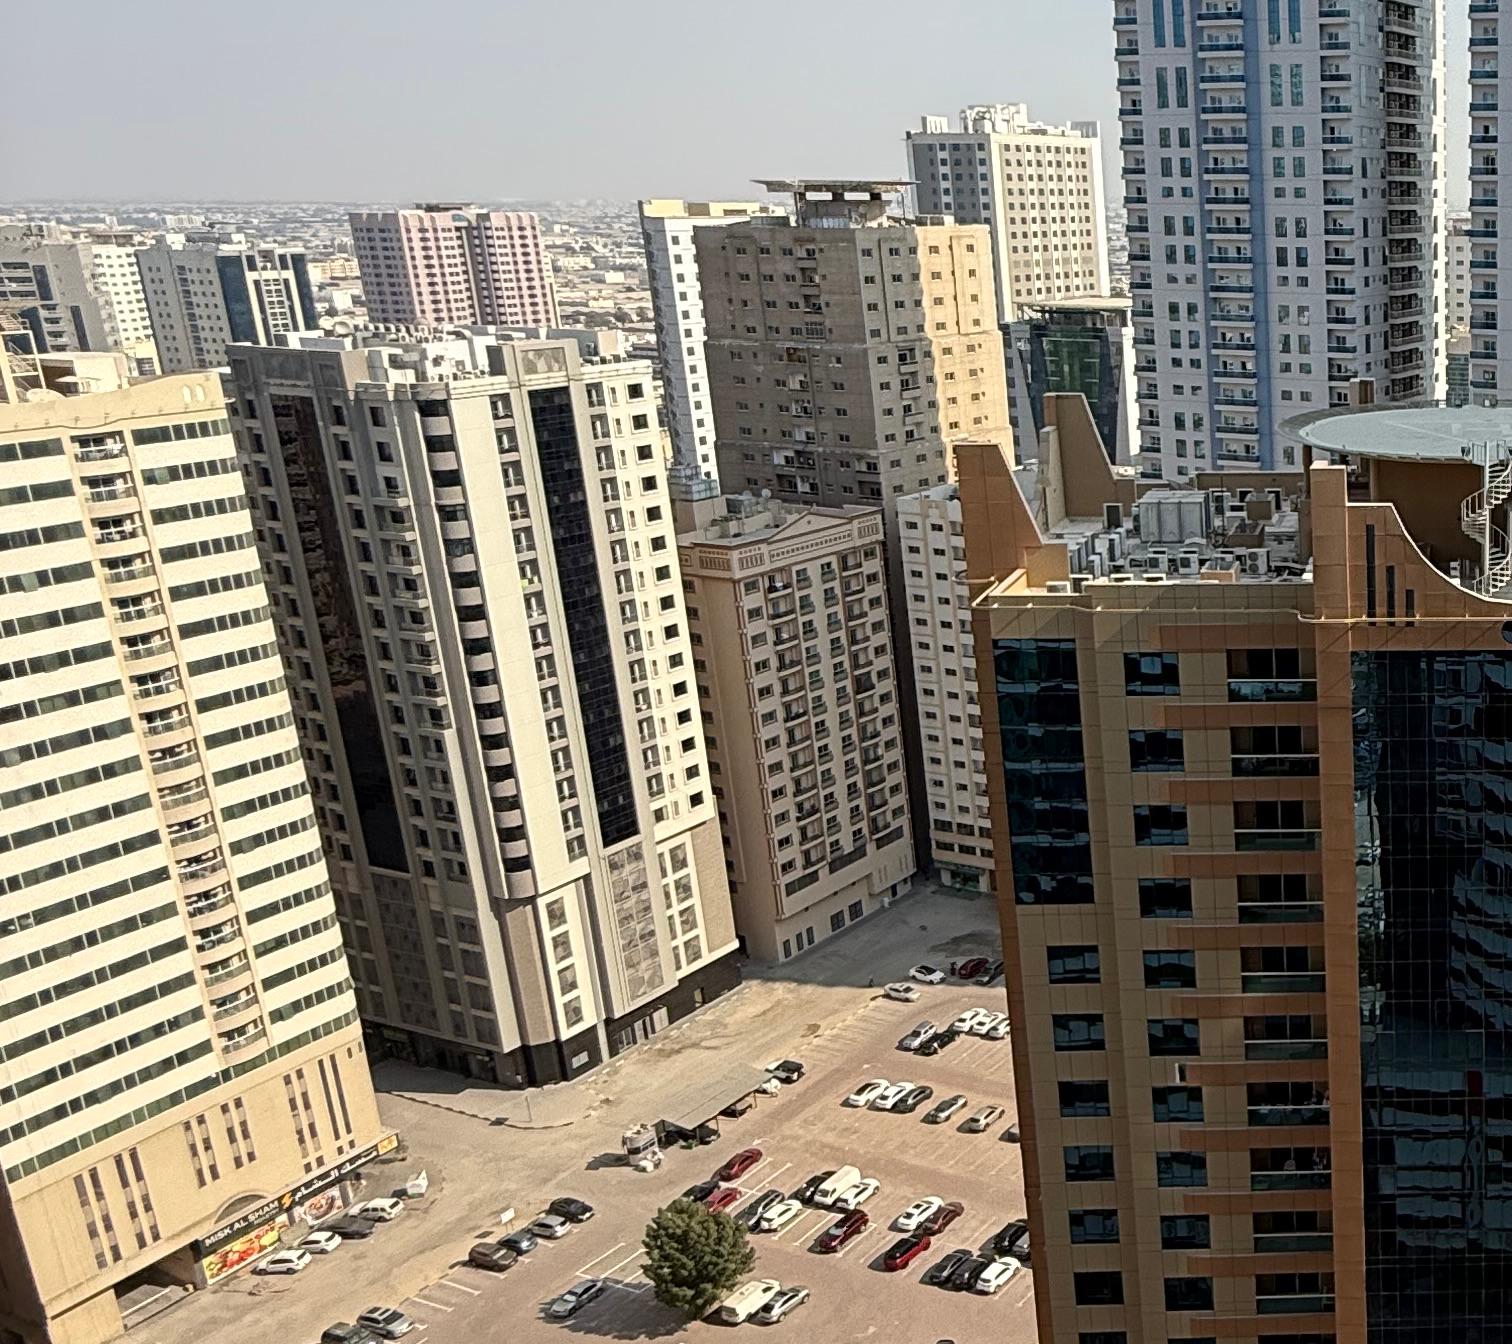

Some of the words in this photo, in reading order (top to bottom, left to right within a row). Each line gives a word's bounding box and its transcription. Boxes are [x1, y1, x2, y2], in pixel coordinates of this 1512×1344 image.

[205, 1228, 233, 1247] MISK
[233, 1218, 249, 1234] AL
[248, 1201, 280, 1223] SHAM
